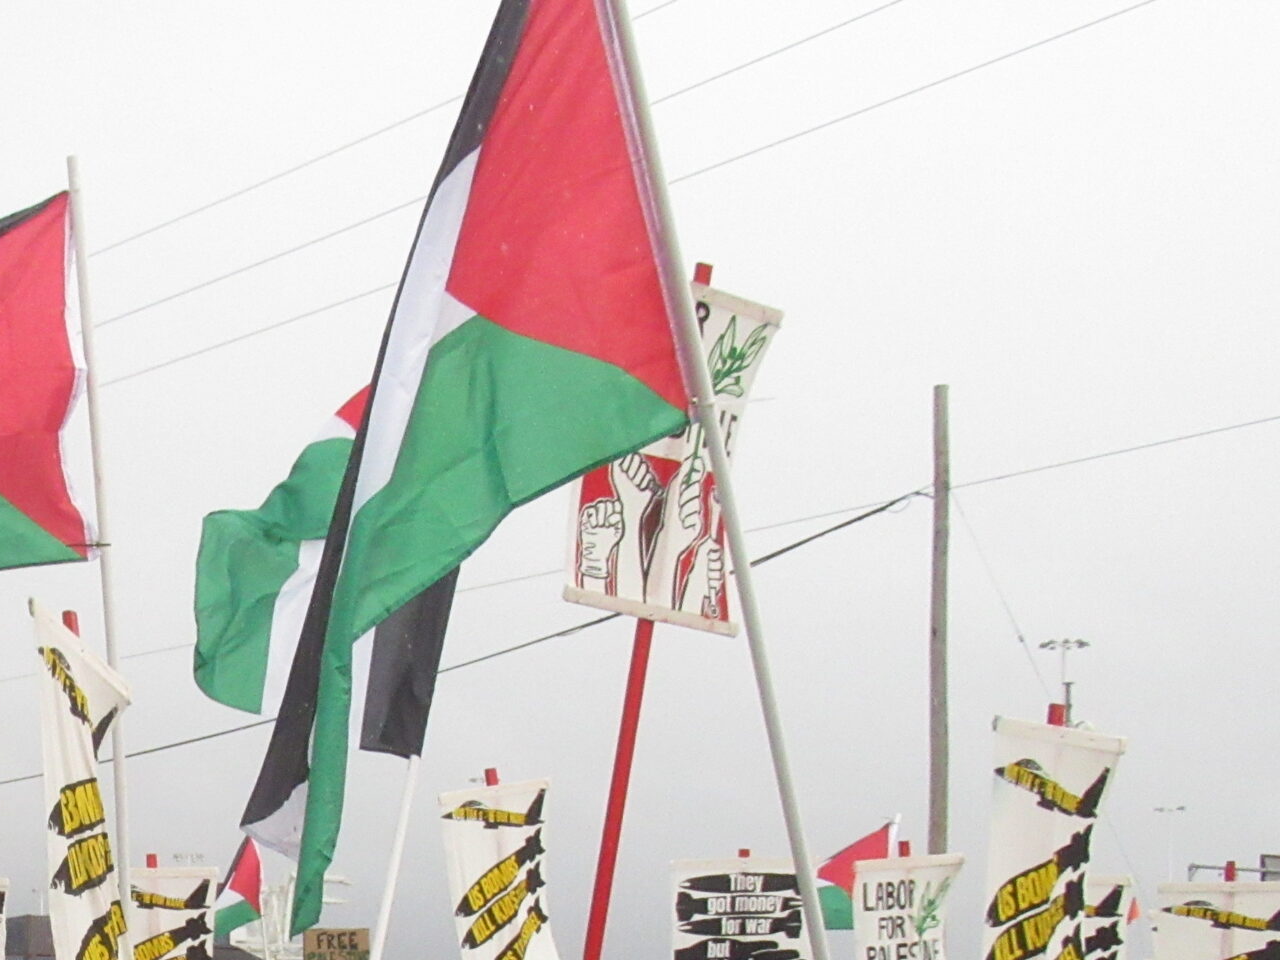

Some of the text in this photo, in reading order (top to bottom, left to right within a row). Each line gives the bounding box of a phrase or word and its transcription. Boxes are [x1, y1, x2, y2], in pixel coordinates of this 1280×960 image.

[467, 883, 486, 911] US
[480, 855, 519, 899] BOMBS
[729, 873, 763, 893] They
[863, 880, 915, 911] LABOR
[707, 896, 783, 915] got money
[721, 917, 773, 935] for war
[878, 915, 905, 939] FOR
[317, 931, 358, 950] FREE
[707, 940, 730, 958] but
